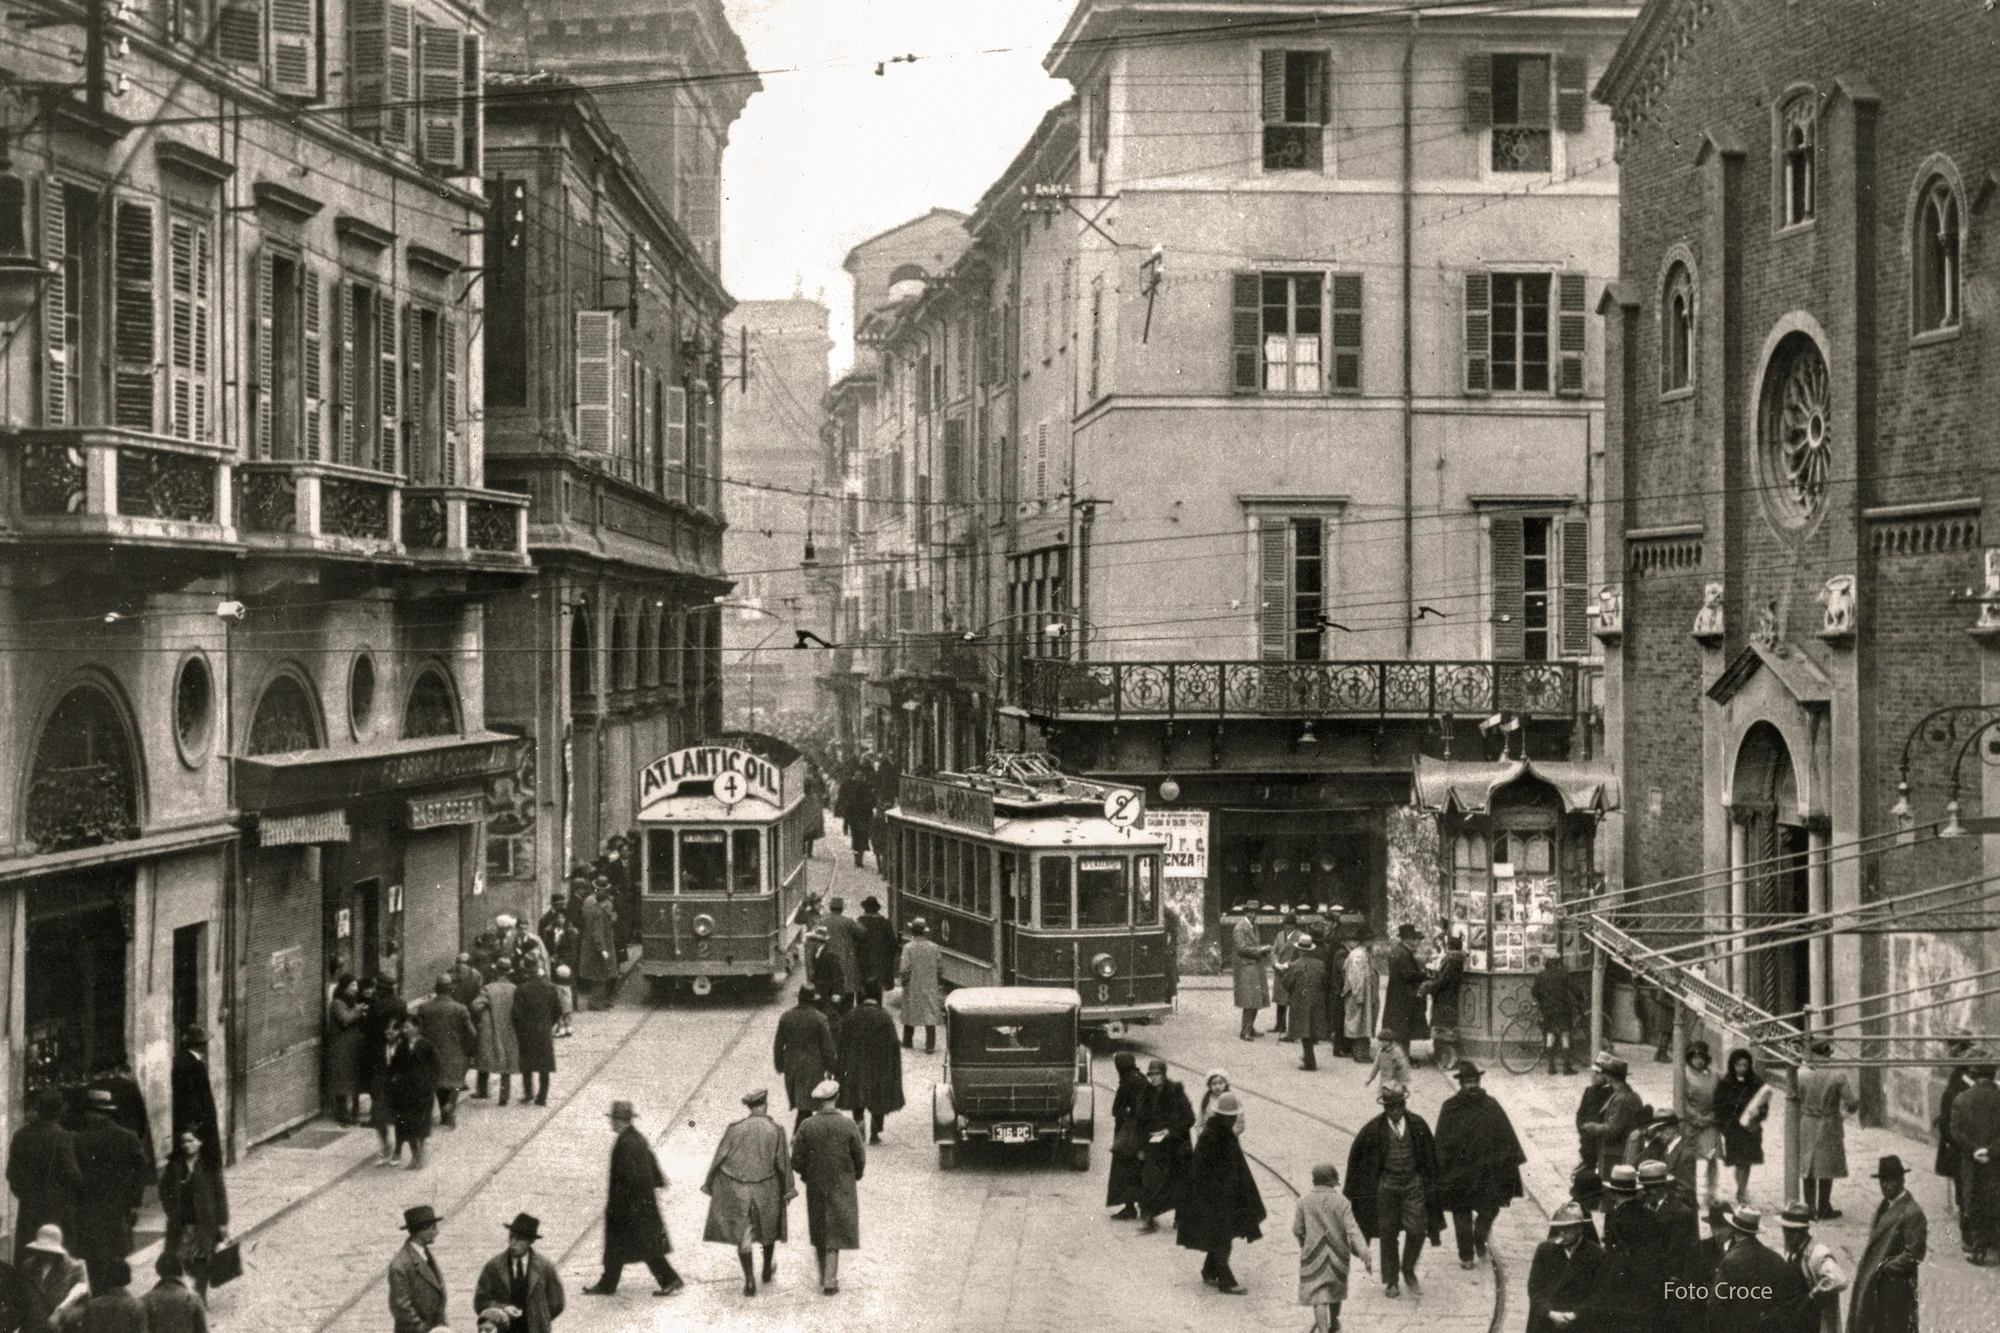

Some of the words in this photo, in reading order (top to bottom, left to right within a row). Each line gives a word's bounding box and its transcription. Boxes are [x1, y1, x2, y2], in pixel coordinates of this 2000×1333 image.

[644, 748, 742, 796] ATLANTIC
[744, 756, 778, 795] OIL
[718, 776, 738, 798] 4
[1115, 795, 1129, 820] 2
[1098, 984, 1109, 1001] 8
